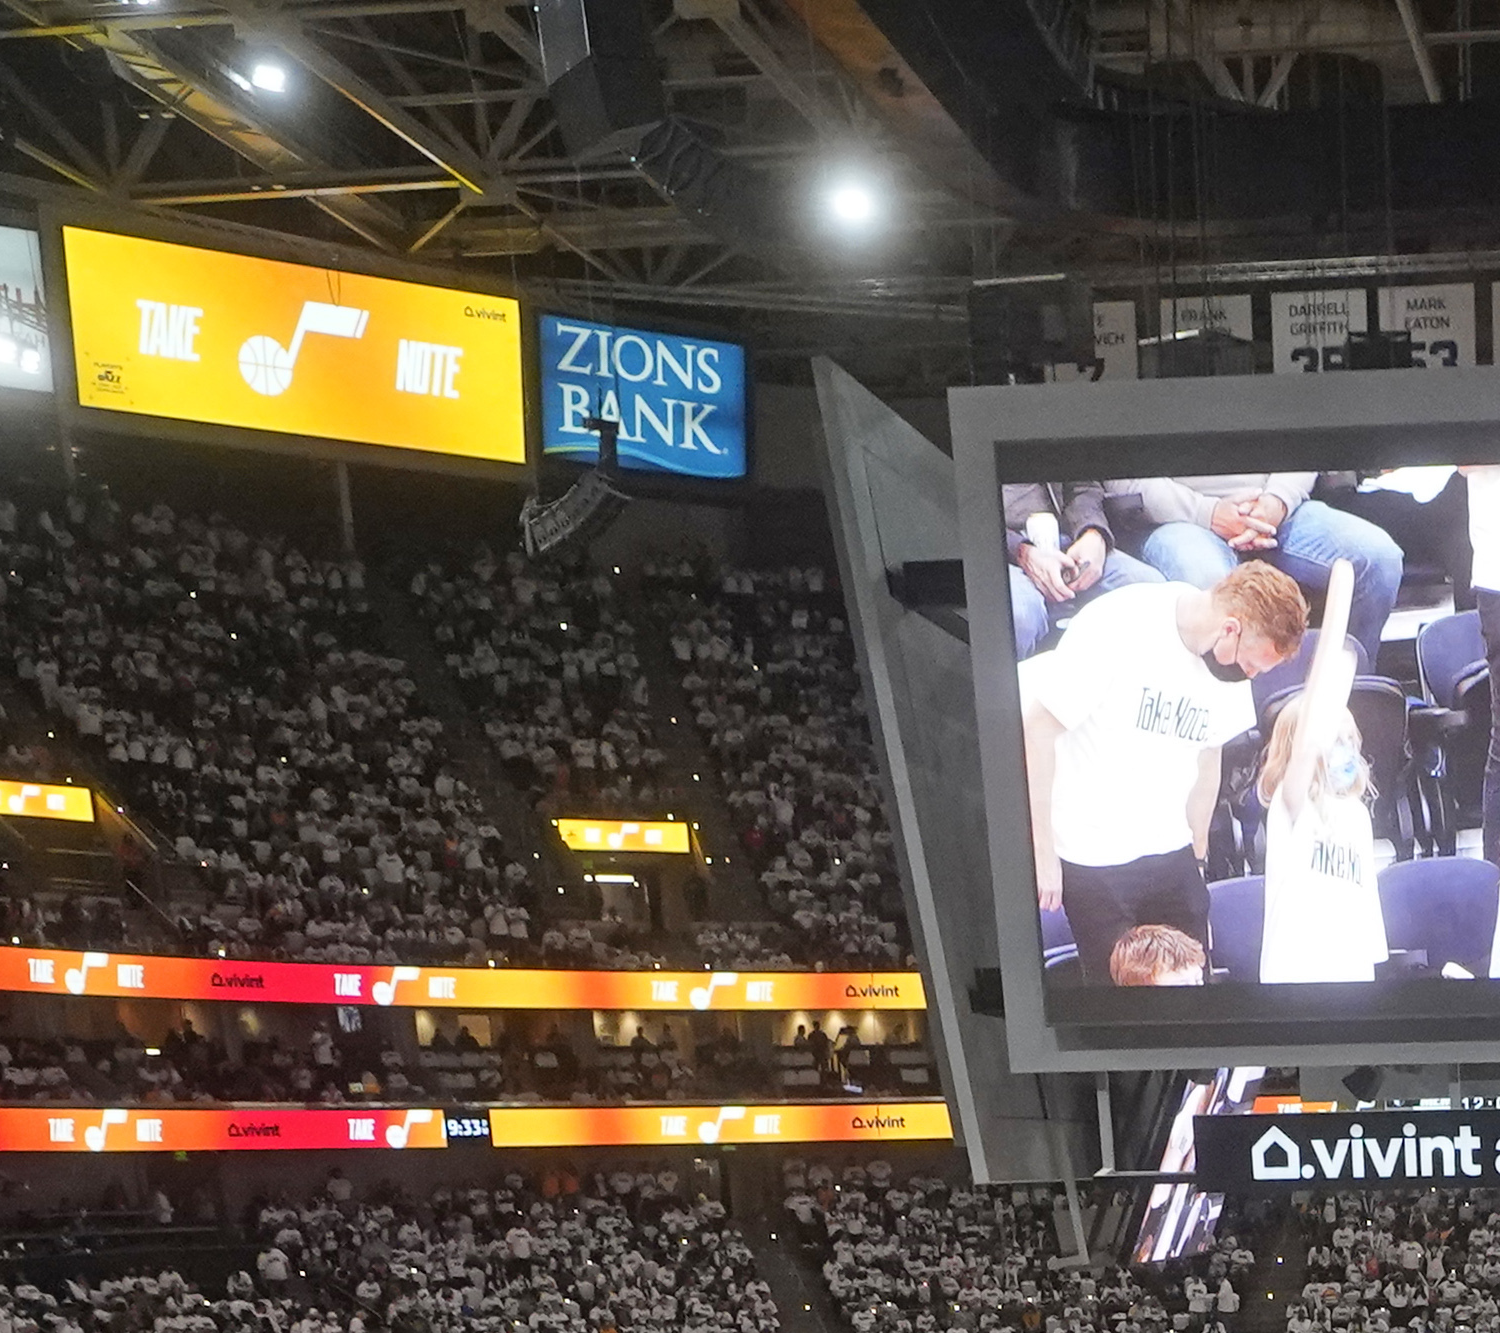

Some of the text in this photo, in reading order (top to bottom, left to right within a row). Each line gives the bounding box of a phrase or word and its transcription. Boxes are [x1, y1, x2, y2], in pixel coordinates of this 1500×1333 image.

[1288, 302, 1349, 321] DARRELL
[1406, 297, 1447, 312] MARK
[473, 306, 506, 324] vivint
[1404, 314, 1452, 332] EATON
[136, 300, 462, 401] TAKE NOTE
[556, 323, 723, 394] ZIONS
[557, 384, 723, 456] BANK
[857, 985, 900, 999] vivint
[862, 1116, 906, 1129] vivint
[1311, 1123, 1482, 1179] vivint
